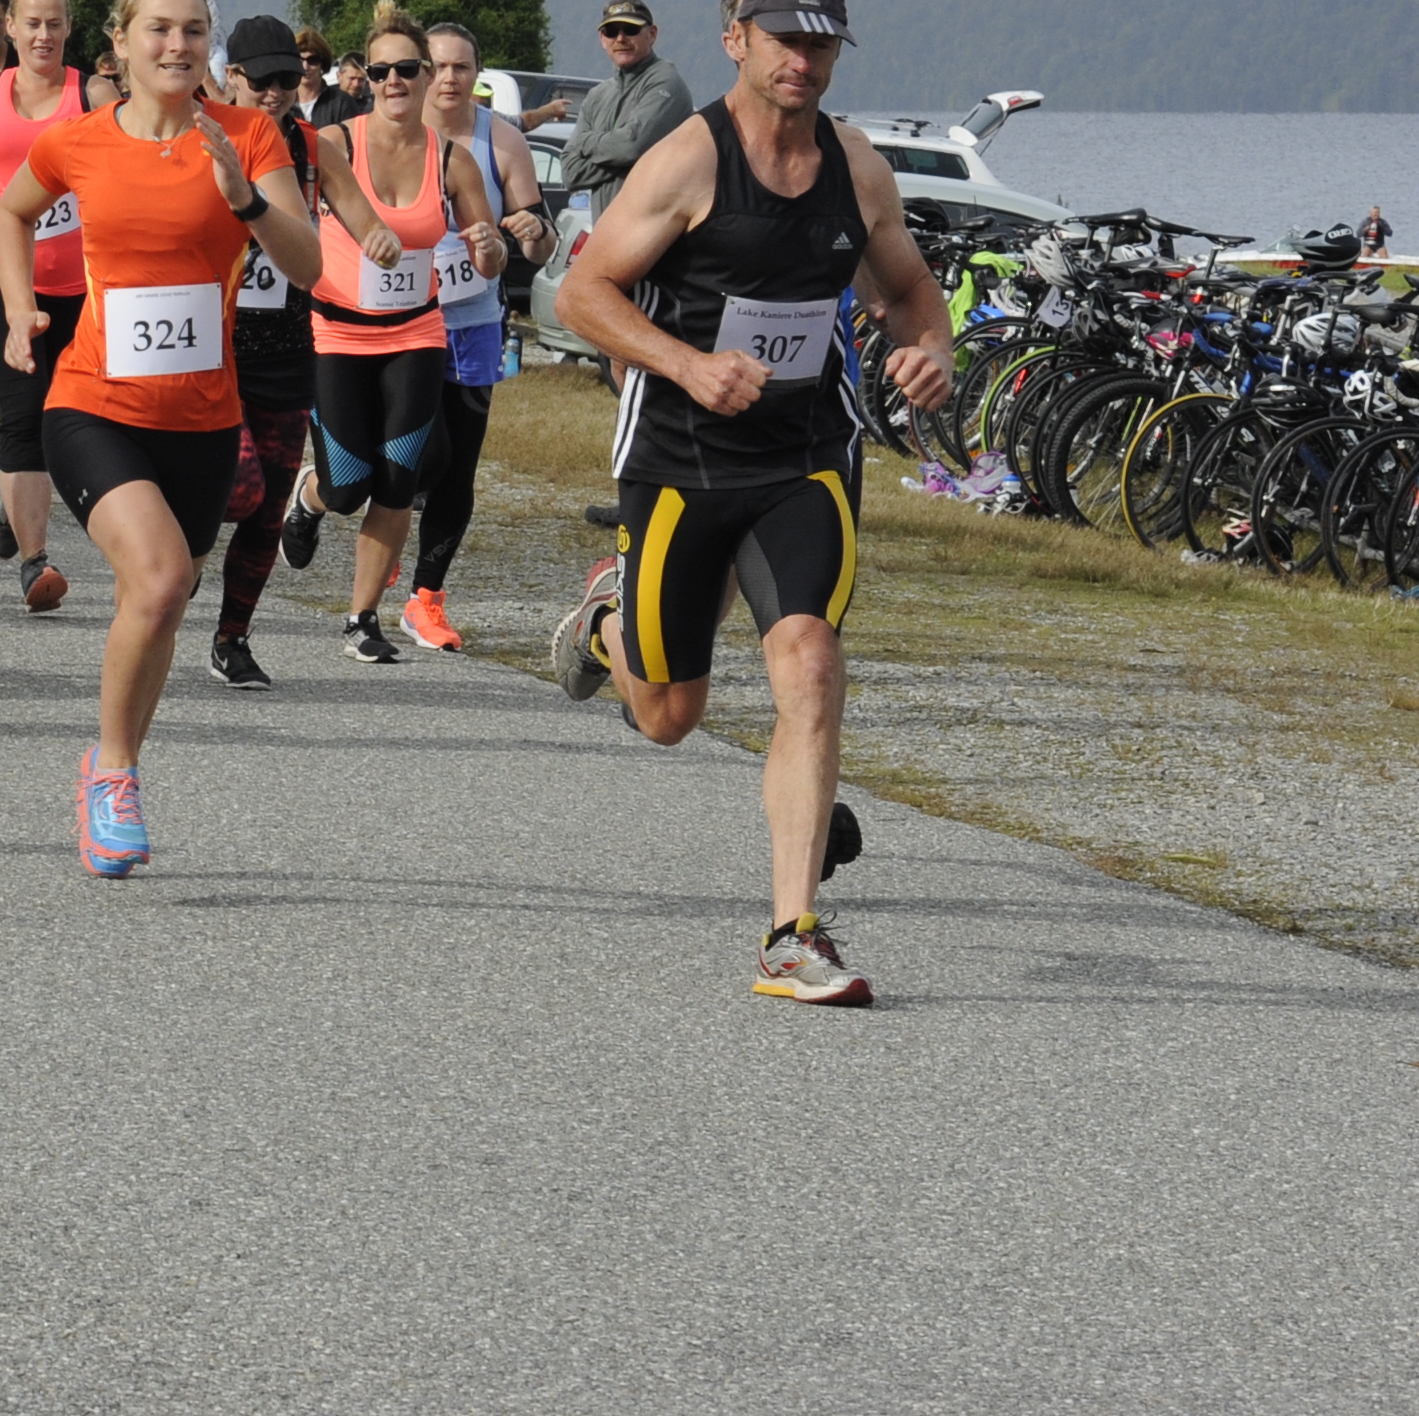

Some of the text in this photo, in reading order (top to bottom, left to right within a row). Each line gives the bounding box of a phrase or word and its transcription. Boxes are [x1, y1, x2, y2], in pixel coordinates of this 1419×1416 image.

[35, 200, 72, 231] 23
[379, 271, 416, 293] 321
[736, 307, 827, 320] Lake Kaniere Duathlon
[132, 316, 198, 352] 324
[751, 334, 808, 363] 307
